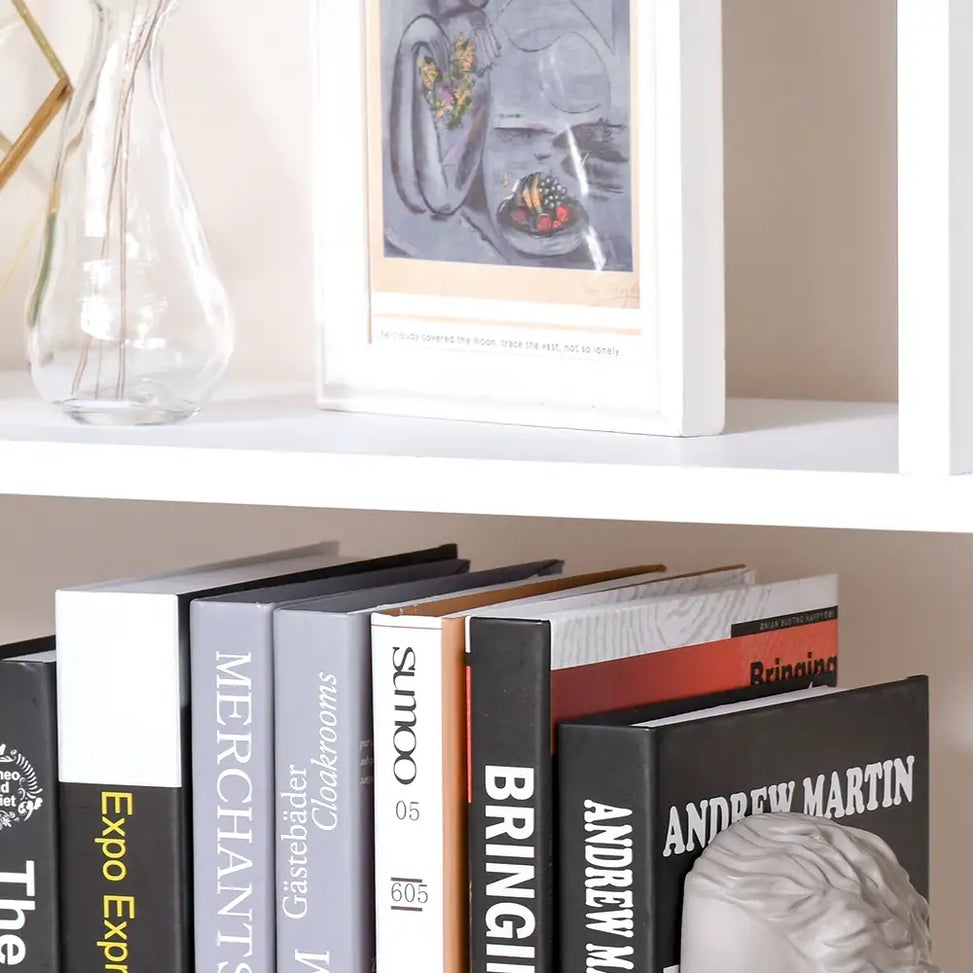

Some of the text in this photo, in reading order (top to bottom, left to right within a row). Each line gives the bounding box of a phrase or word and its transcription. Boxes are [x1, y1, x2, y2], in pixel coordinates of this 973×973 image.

[525, 340, 539, 350] the
[581, 345, 591, 354] so
[310, 672, 337, 830] Cloakrooms
[802, 754, 916, 822] MARTIN
[95, 792, 133, 881] Expo
[281, 765, 307, 918] Gästebäder
[396, 801, 419, 821] 05
[0, 861, 35, 965] The
[391, 882, 428, 903] 605
[584, 800, 633, 937] ANDREW
